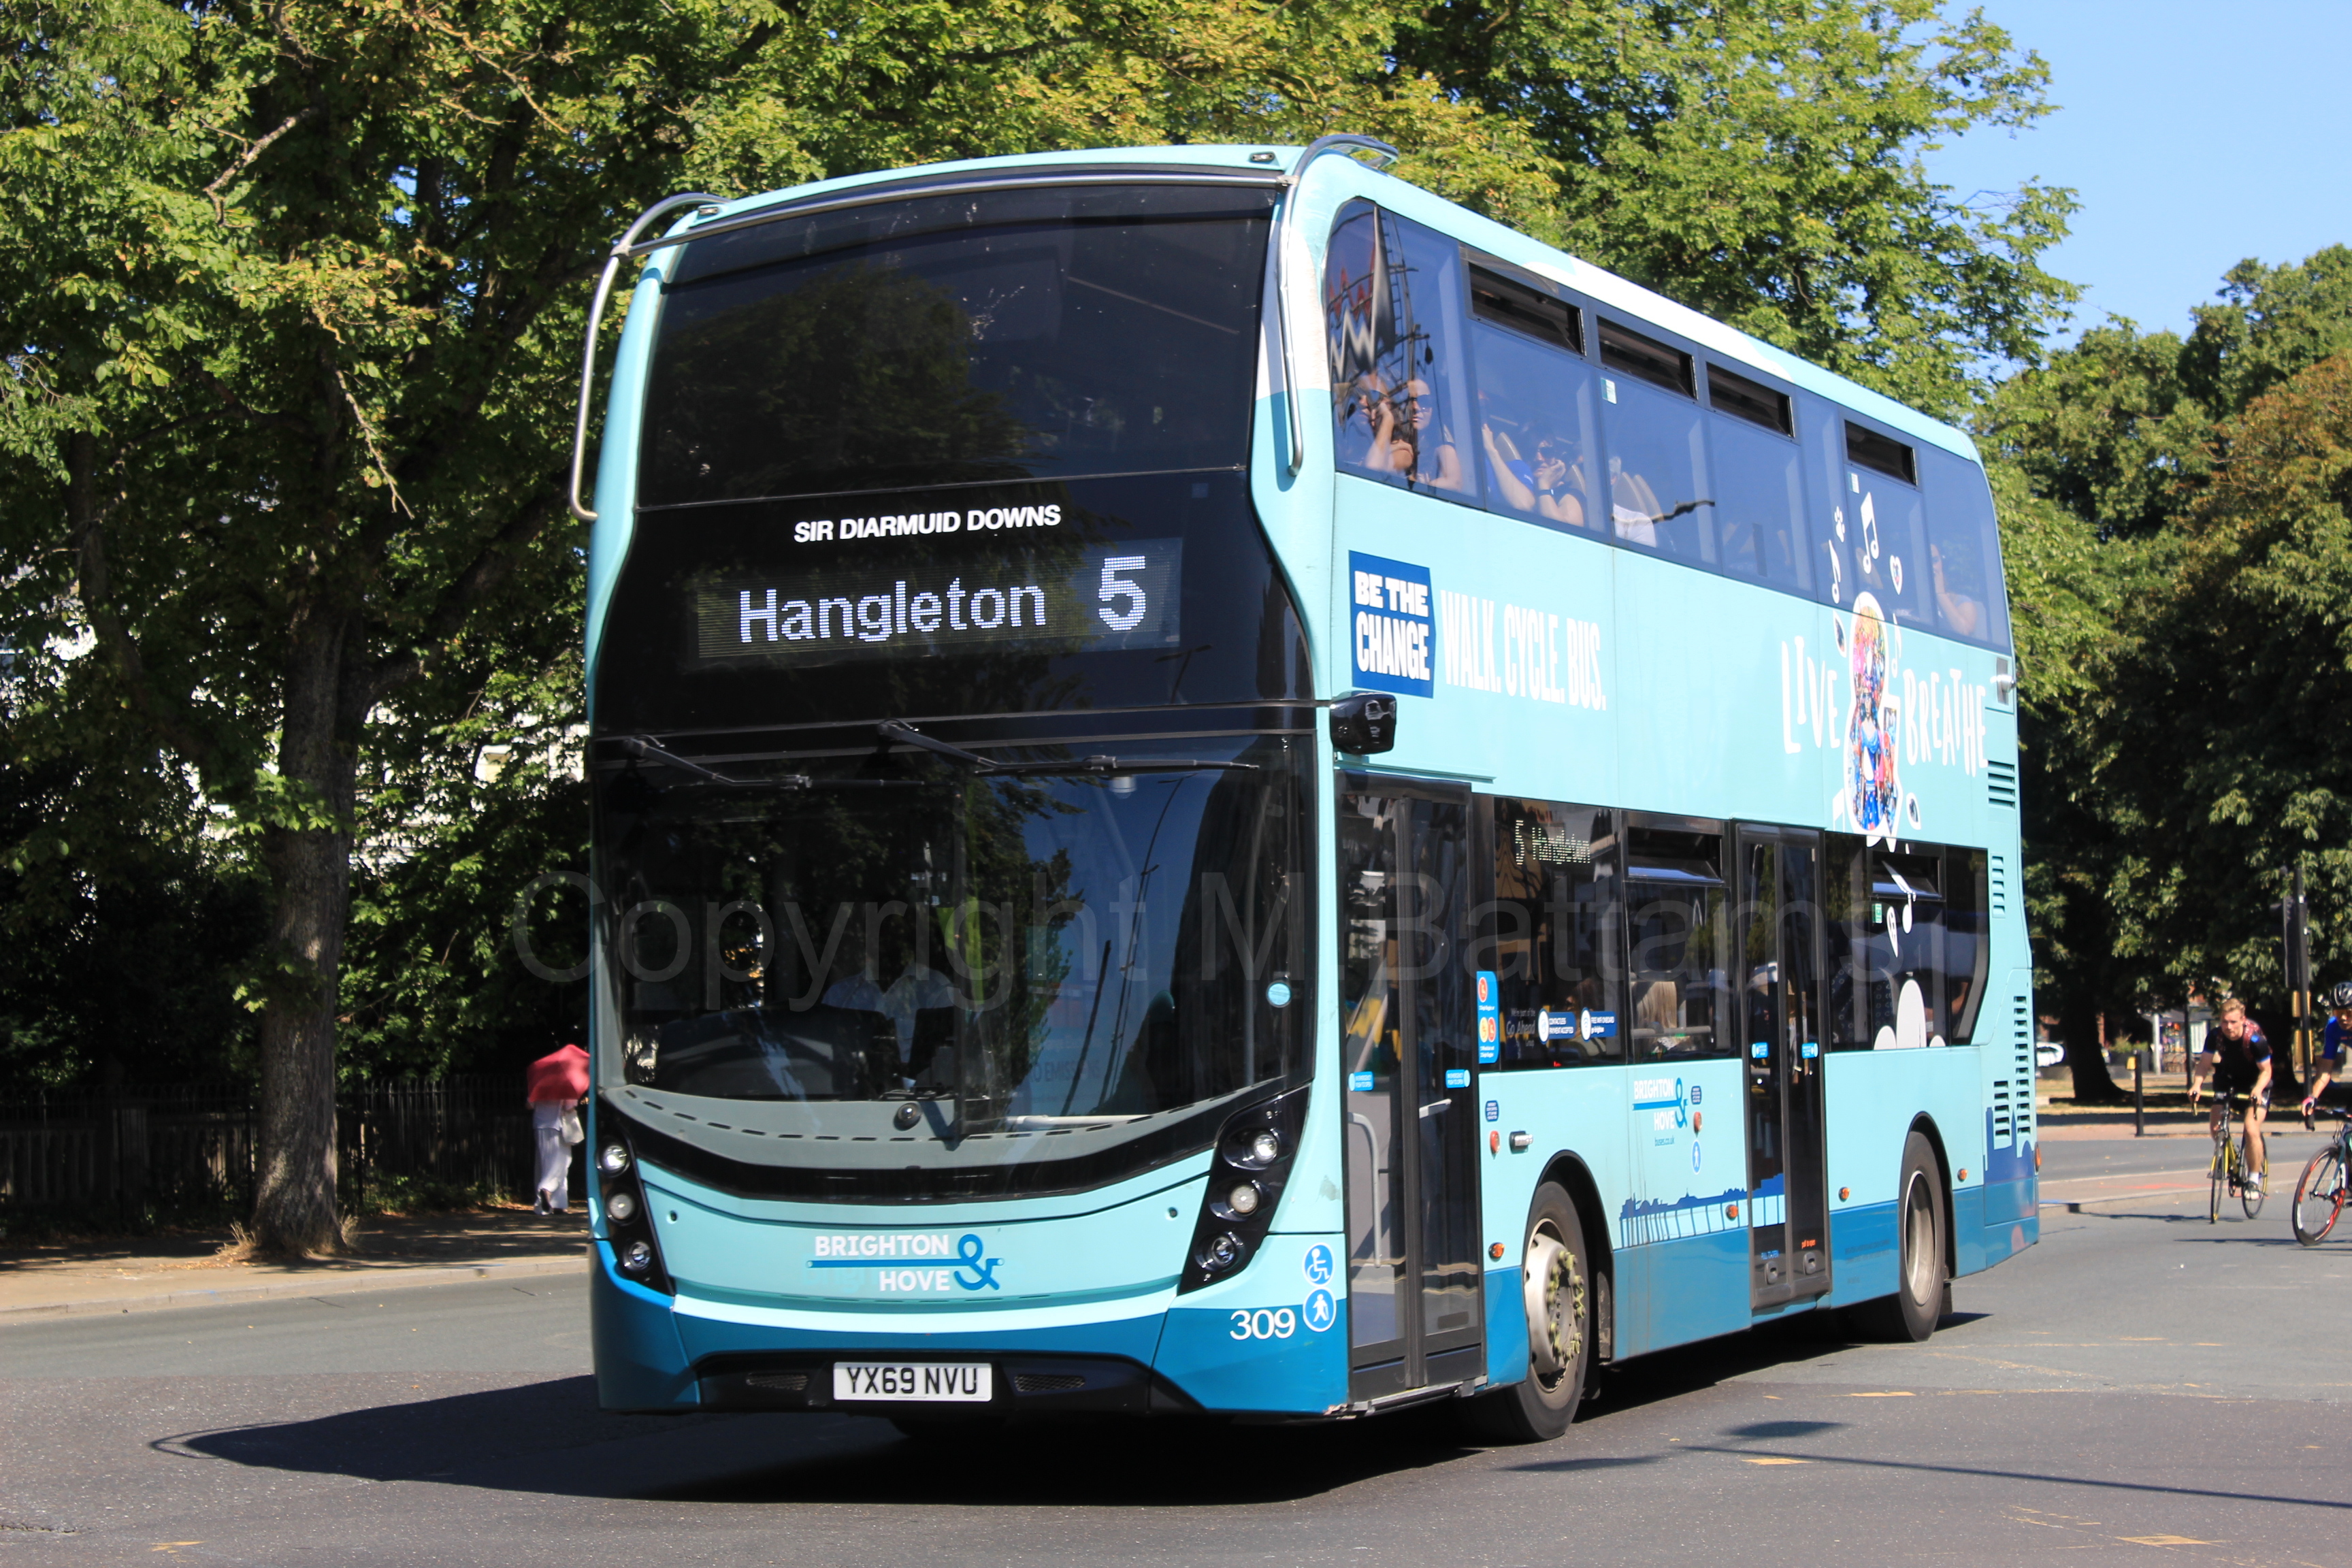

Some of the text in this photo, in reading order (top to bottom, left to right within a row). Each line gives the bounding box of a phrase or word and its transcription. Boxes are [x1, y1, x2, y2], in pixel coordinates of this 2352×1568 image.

[794, 504, 1062, 543] SIR DIARMUID DOWNS
[740, 555, 1147, 643] Hangleton 5
[1354, 570, 1428, 617] BE THE
[1356, 610, 1431, 681] CHANGE
[1440, 589, 1607, 711] WALK. CYCLE. BUS.
[1903, 668, 1989, 778] BREATHE
[1633, 1078, 1674, 1100] BRIGHTON
[1653, 1110, 1675, 1130] HOVE
[815, 1233, 1004, 1291] BRIGHTON &
[879, 1270, 950, 1292] HOVE
[1230, 1308, 1296, 1340] 309
[847, 1367, 978, 1395] YX69 NVU
